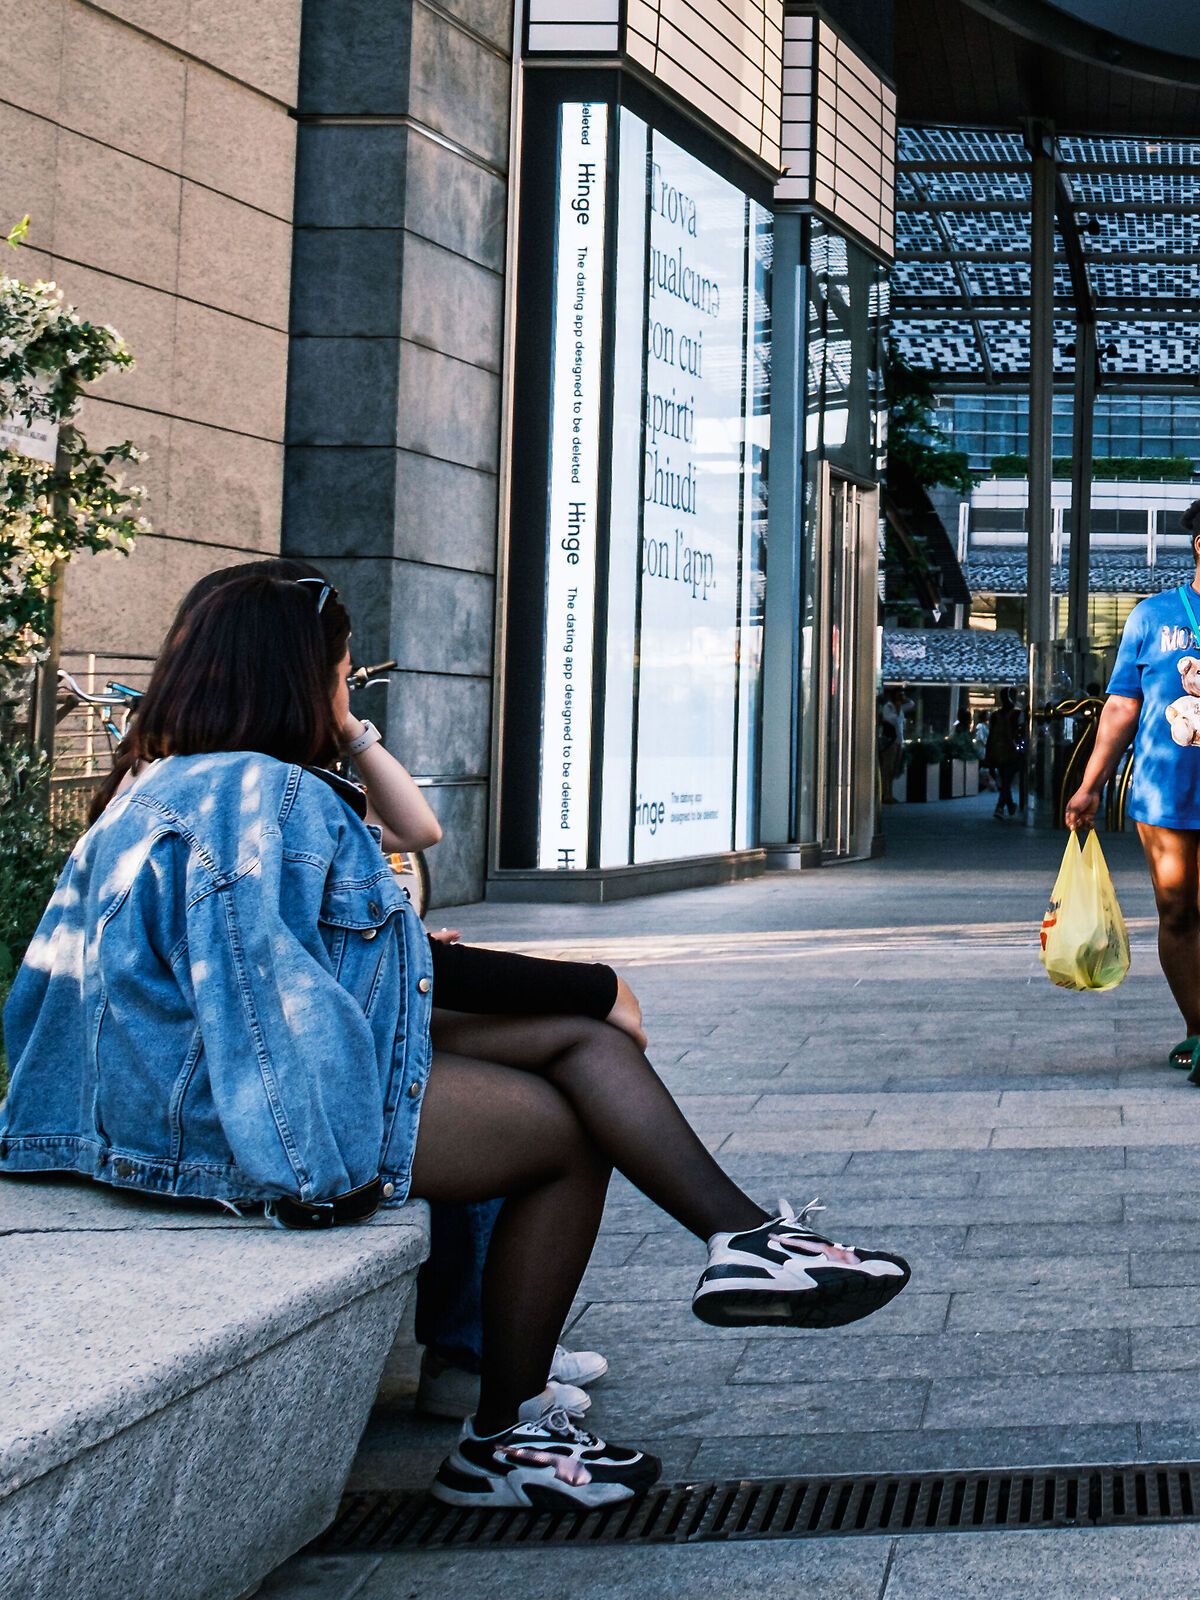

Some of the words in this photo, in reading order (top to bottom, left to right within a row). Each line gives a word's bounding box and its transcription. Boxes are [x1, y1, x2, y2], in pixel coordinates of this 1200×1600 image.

[571, 163, 596, 225] Hinge
[577, 247, 587, 268] The
[574, 272, 586, 311] dating
[573, 315, 583, 337] app
[572, 341, 585, 397] designed
[680, 330, 703, 379] cui
[573, 402, 583, 413] to
[573, 418, 582, 433] be
[571, 437, 582, 484] deleted
[561, 502, 586, 565] Hinge
[567, 587, 577, 609] The
[563, 613, 576, 652] dating
[563, 657, 573, 680] app
[561, 684, 574, 741] designed
[562, 762, 572, 778] be
[563, 746, 573, 758] to
[560, 782, 572, 829] deleted
[636, 793, 665, 835] inge
